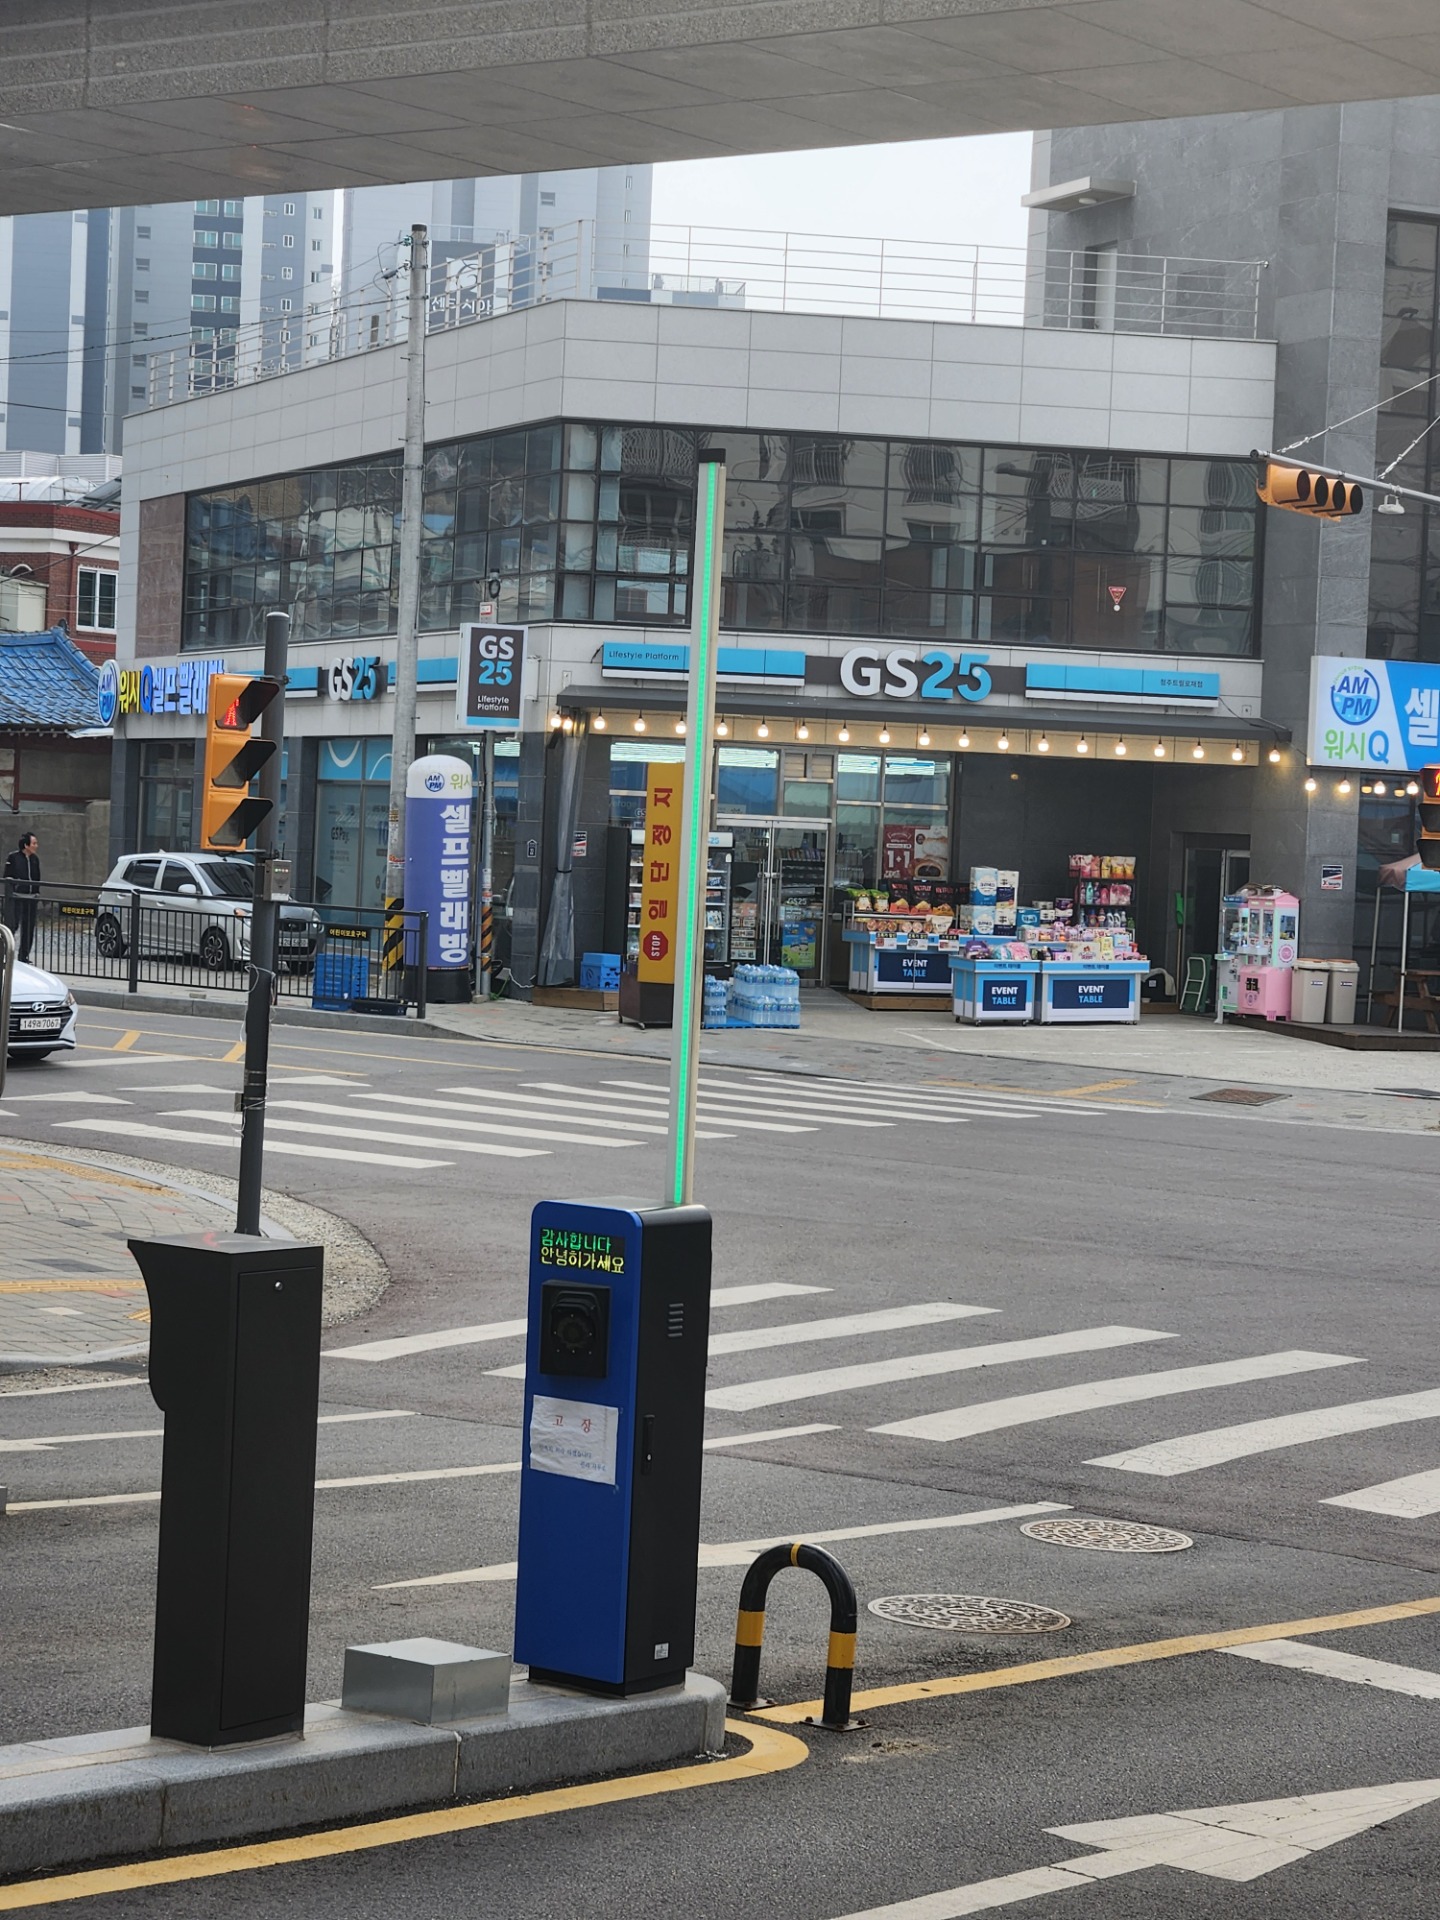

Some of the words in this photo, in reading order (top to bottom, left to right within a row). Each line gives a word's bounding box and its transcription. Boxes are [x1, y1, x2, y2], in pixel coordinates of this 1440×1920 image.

[479, 635, 515, 660] GS
[609, 651, 643, 659] Lifestyle
[645, 652, 680, 661] Platform
[328, 656, 379, 700] GS25
[478, 660, 513, 686] 25
[840, 647, 992, 702] GS25
[1337, 675, 1370, 695] AM
[477, 695, 510, 705] Lifestyle
[1341, 697, 1373, 716] PM
[477, 703, 510, 712] Platform
[1323, 729, 1389, 764] 워시Q
[439, 804, 470, 963] 셀프빨래방
[329, 928, 367, 938] 어린이보호구역
[651, 934, 662, 957] STOP
[902, 959, 928, 967] EVENT
[903, 969, 926, 977] TABLE
[991, 986, 1018, 995] EVENT
[1078, 985, 1104, 993] EVENT
[992, 997, 1016, 1005] TABLE
[1079, 995, 1103, 1003] TABLE
[541, 1228, 612, 1254] 감사합니다
